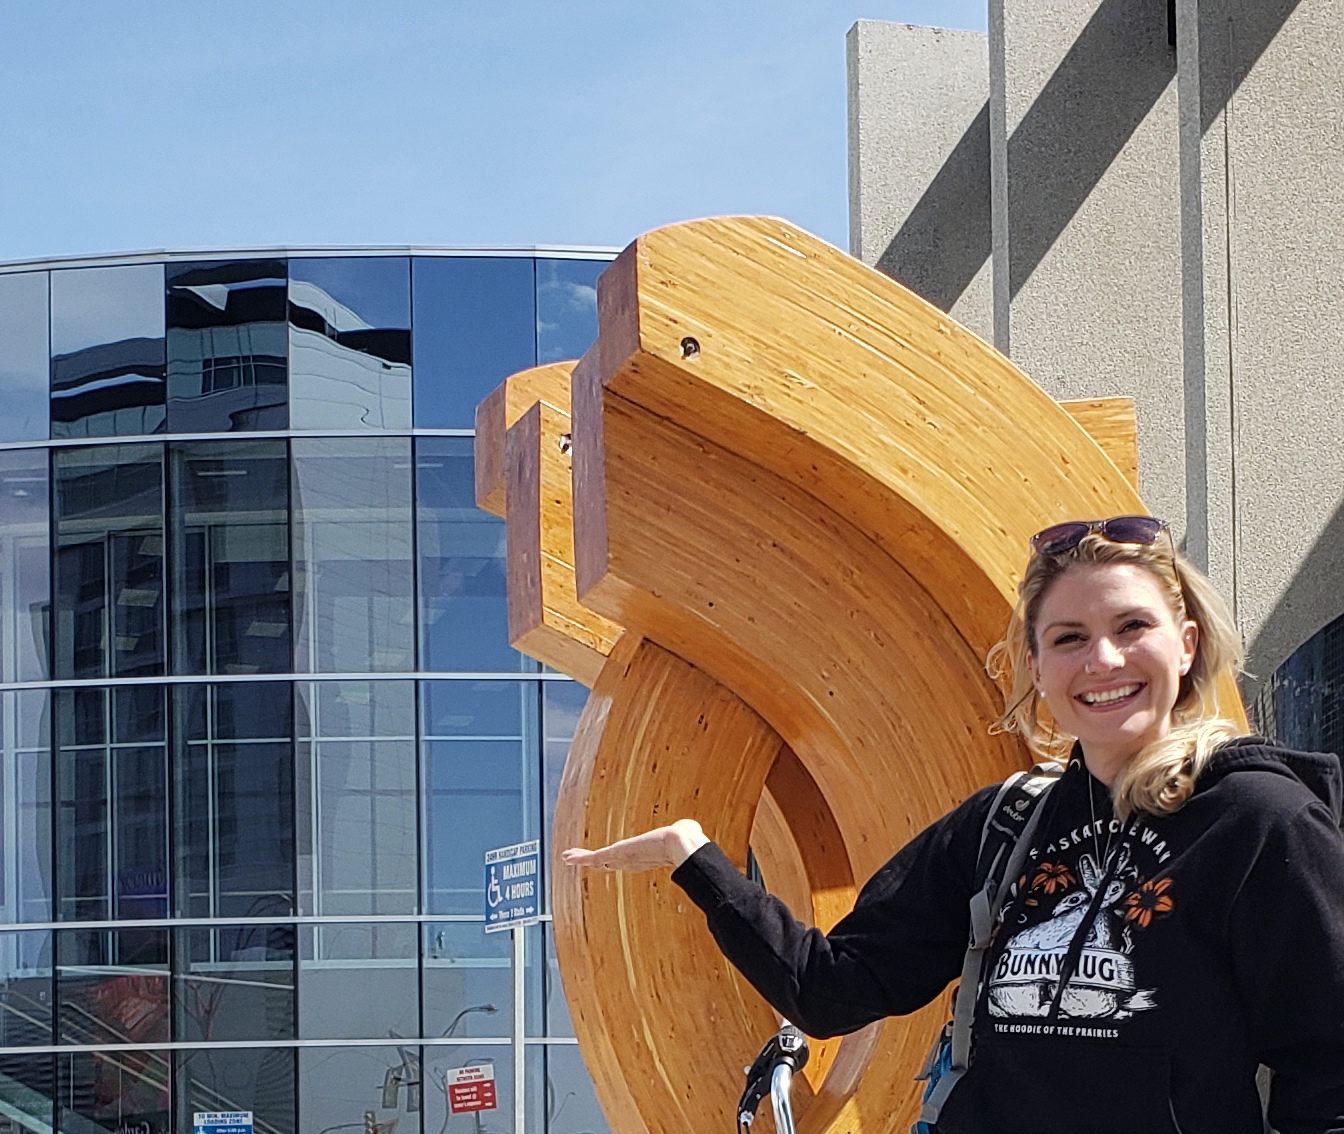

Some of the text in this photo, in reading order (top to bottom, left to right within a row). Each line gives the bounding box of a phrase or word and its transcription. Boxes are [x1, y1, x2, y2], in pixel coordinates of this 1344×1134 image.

[503, 859, 536, 880] MAXIMUM
[505, 881, 534, 900] 4 HOURS
[994, 1023, 1119, 1038] THE HOODIE OF THE PRAIRIES
